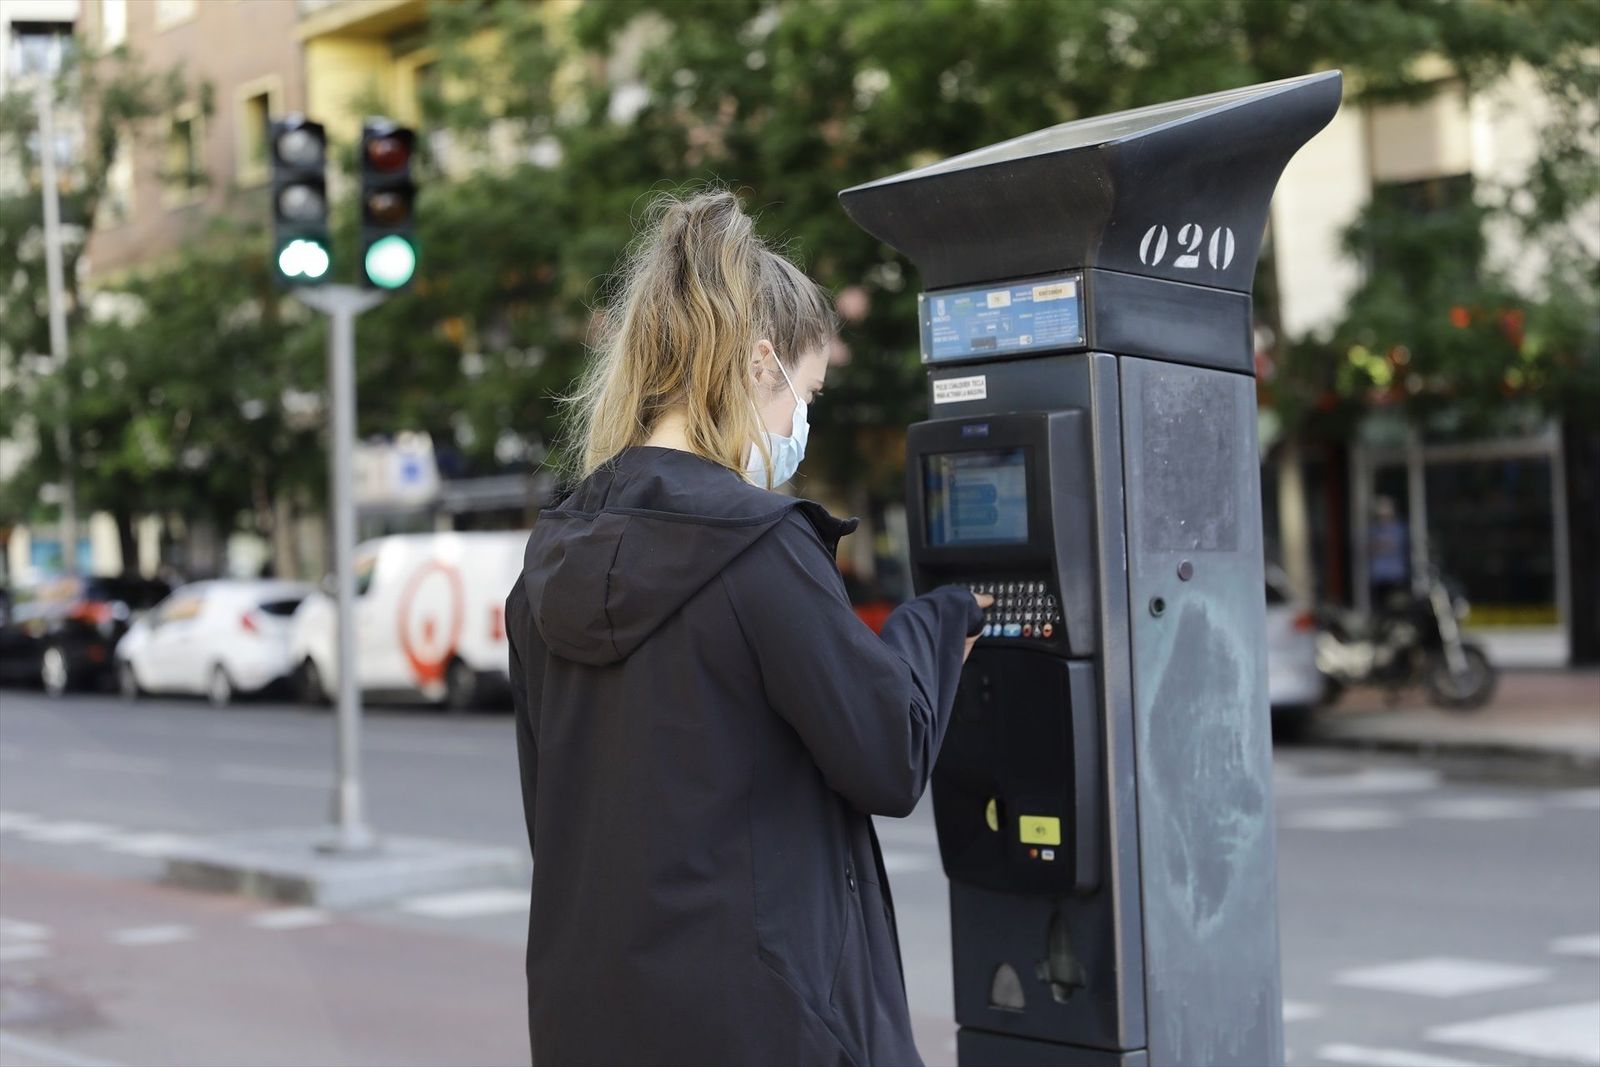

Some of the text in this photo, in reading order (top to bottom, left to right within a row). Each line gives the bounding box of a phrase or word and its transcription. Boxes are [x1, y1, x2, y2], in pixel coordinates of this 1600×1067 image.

[1139, 223, 1235, 270] 020
[999, 584, 1004, 593] 5
[1008, 584, 1013, 593] 6
[1019, 584, 1024, 593] 7
[1028, 583, 1033, 593] 8
[1039, 583, 1044, 593] 9
[1024, 612, 1032, 620] W
